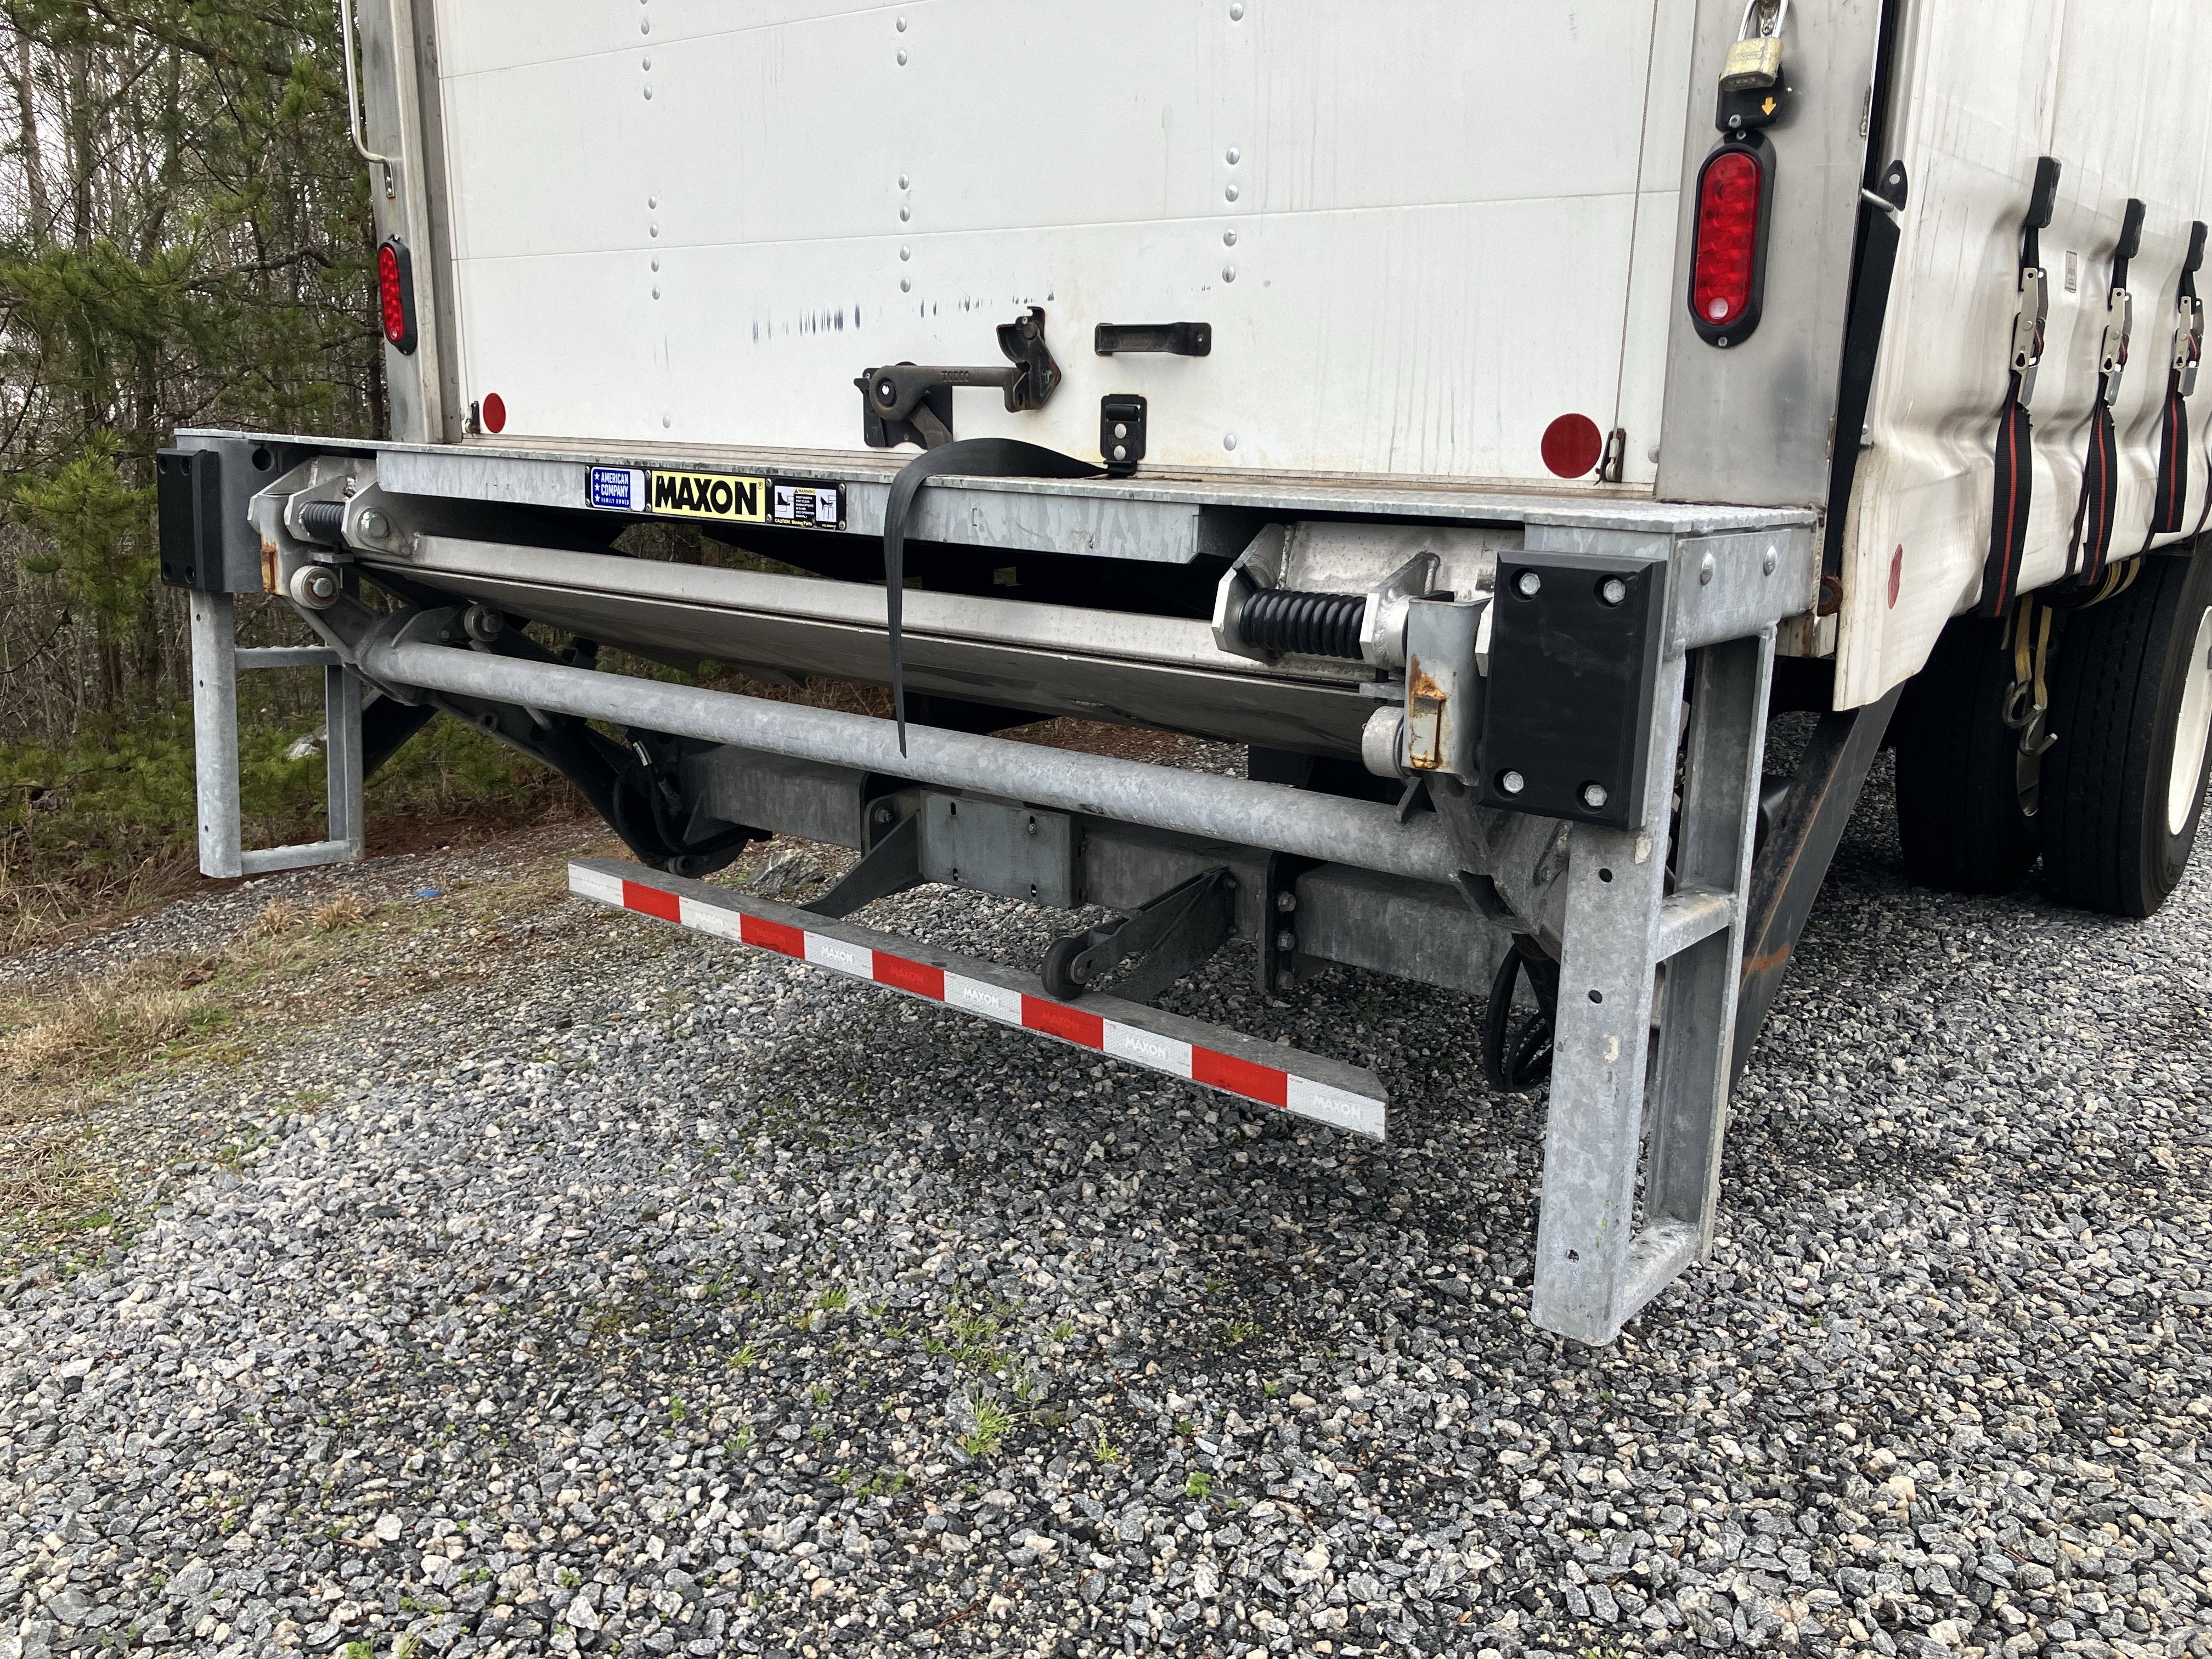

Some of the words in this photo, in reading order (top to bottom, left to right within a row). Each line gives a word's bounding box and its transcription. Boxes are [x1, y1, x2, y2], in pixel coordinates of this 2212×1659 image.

[601, 472, 629, 485] AMERICAN
[601, 484, 629, 498] COMPANY
[655, 475, 758, 516] MAXON
[822, 945, 853, 963] MAXON
[964, 987, 999, 1006] MAXON
[1125, 1036, 1166, 1059] MAXON
[1313, 1094, 1361, 1122] MAXON
